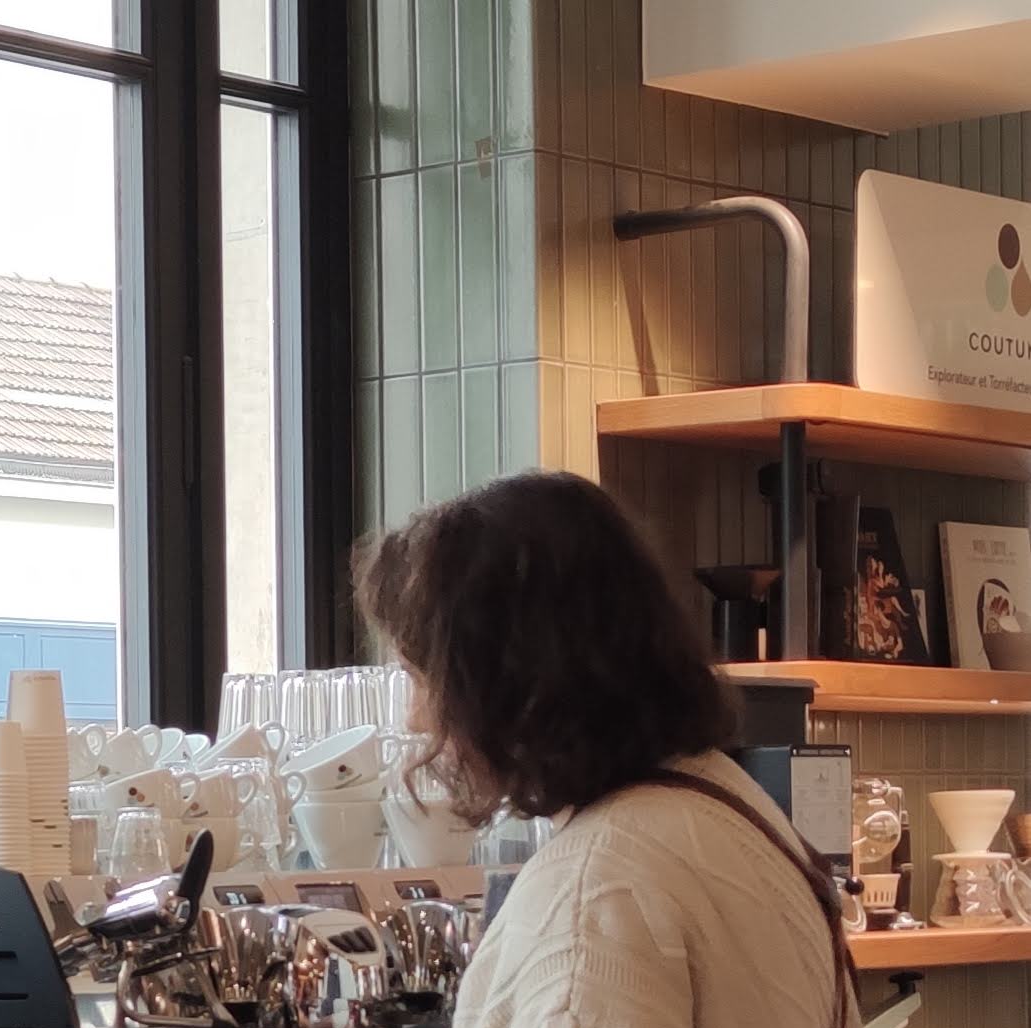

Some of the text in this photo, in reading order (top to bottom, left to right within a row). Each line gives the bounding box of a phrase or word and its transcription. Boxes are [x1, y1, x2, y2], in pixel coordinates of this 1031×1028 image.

[928, 365, 1031, 395] Explorateur et Torréfacte
